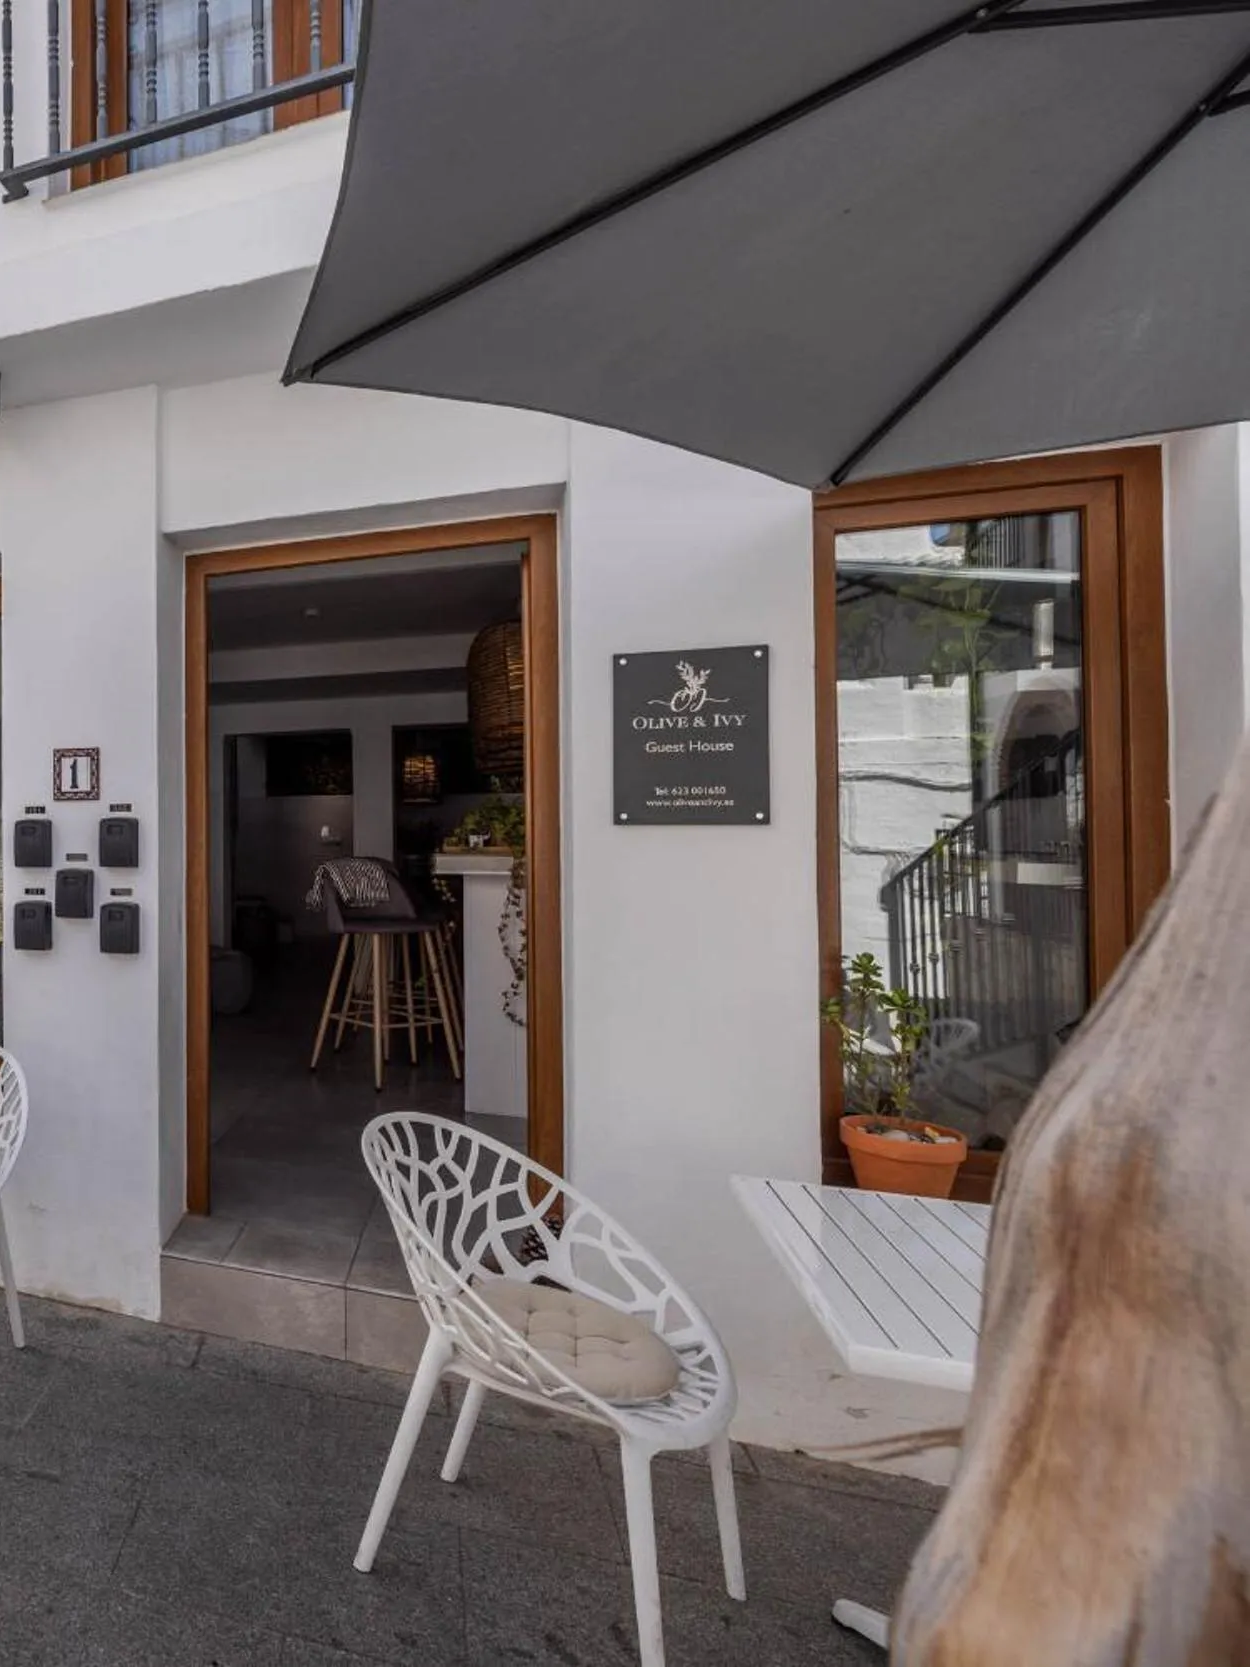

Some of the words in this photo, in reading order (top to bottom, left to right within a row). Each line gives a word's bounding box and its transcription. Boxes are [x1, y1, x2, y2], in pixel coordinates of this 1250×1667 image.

[632, 716, 689, 730] OLIVE
[693, 716, 707, 728] &
[713, 713, 746, 727] IVY
[645, 741, 685, 753] Guest
[689, 740, 734, 752] House
[69, 758, 79, 789] 1
